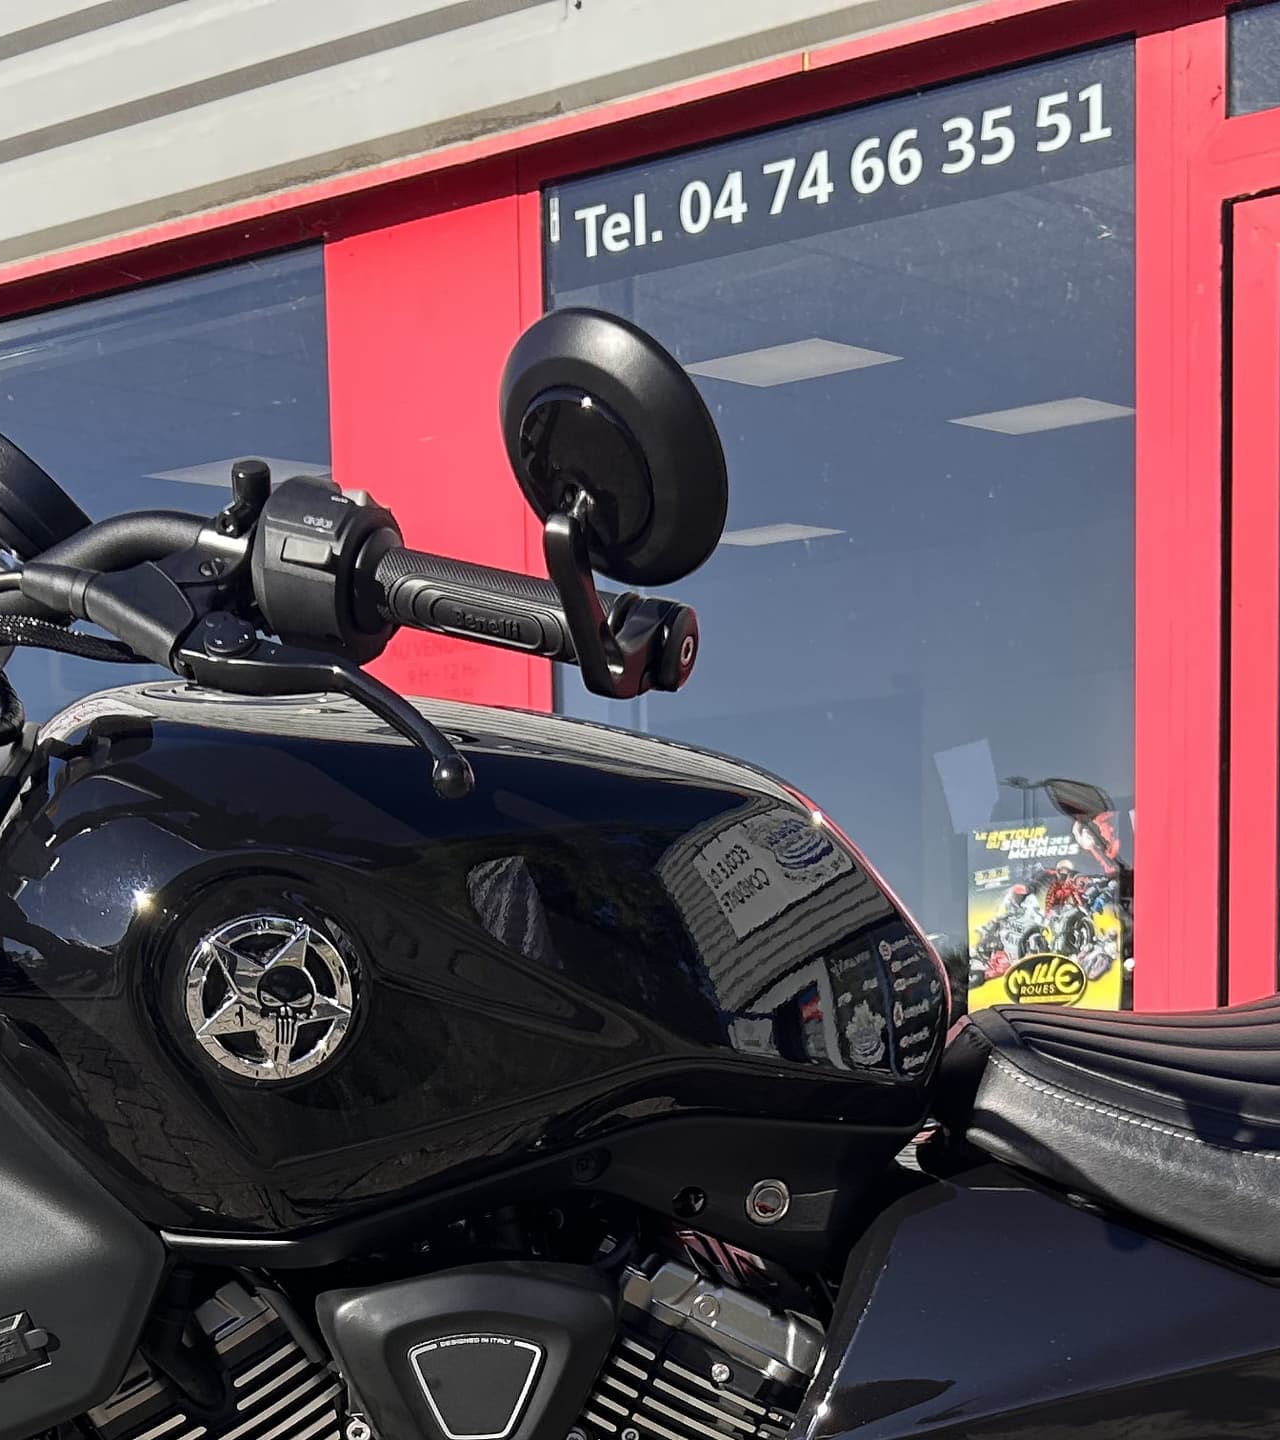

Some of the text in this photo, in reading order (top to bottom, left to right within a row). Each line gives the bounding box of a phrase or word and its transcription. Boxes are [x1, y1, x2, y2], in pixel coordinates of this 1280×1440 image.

[574, 82, 1113, 258] Tel. 04 74 66 35 51
[987, 826, 1047, 841] RETOUR
[1000, 836, 1049, 851] SALON
[1007, 843, 1080, 860] MOTARDS
[1020, 984, 1056, 995] ROUES
